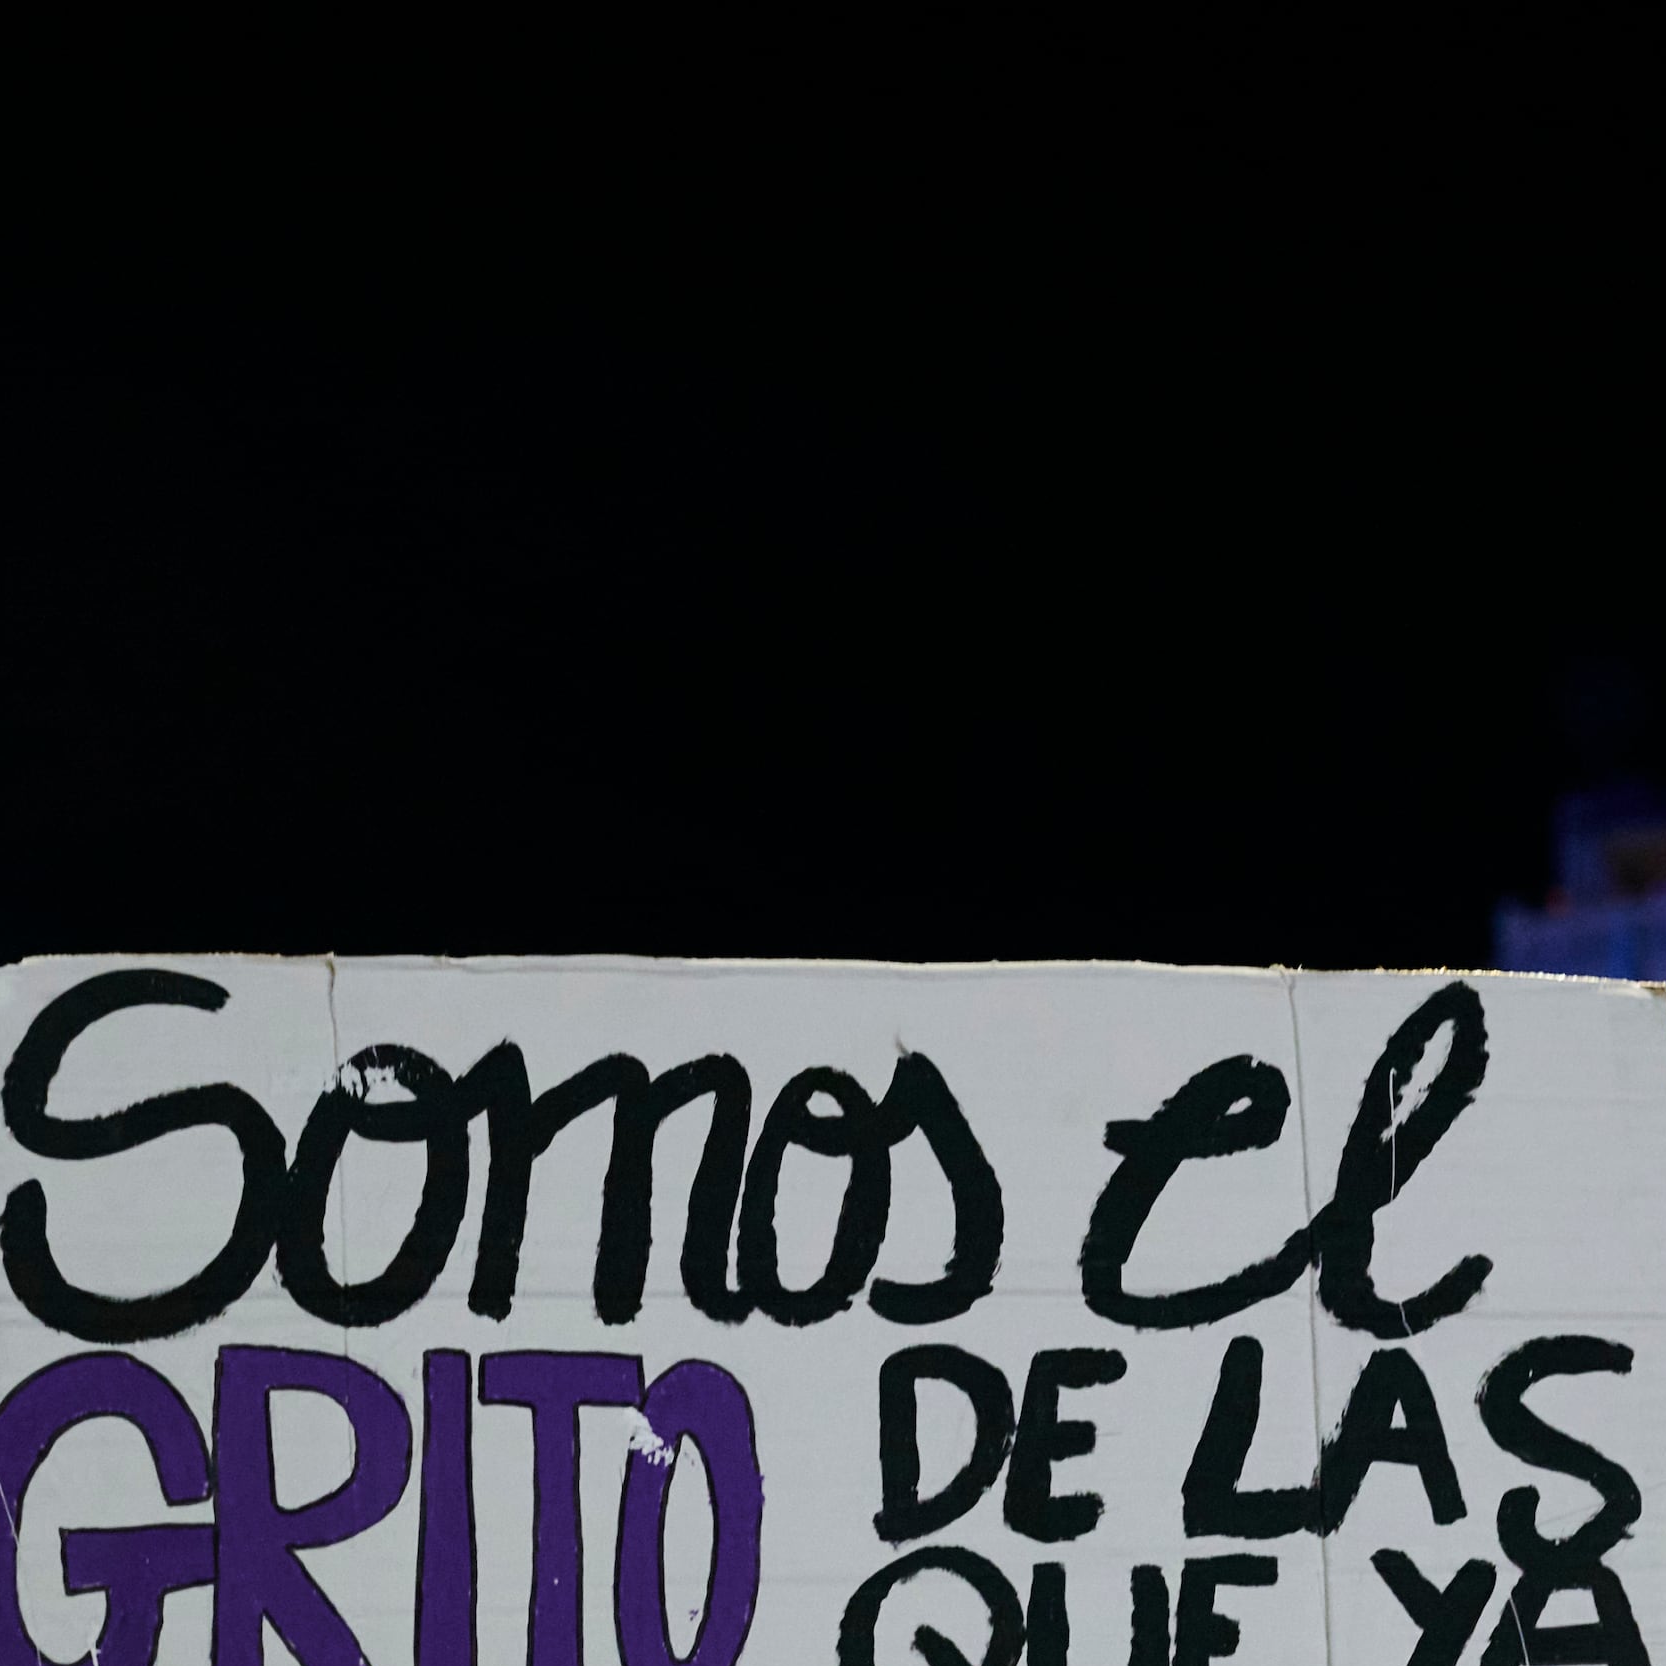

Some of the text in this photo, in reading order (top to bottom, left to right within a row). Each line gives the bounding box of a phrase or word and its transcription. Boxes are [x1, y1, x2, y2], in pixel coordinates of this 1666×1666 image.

[0, 968, 1493, 1342] Somos el
[875, 1335, 1643, 1560] DE LAS
